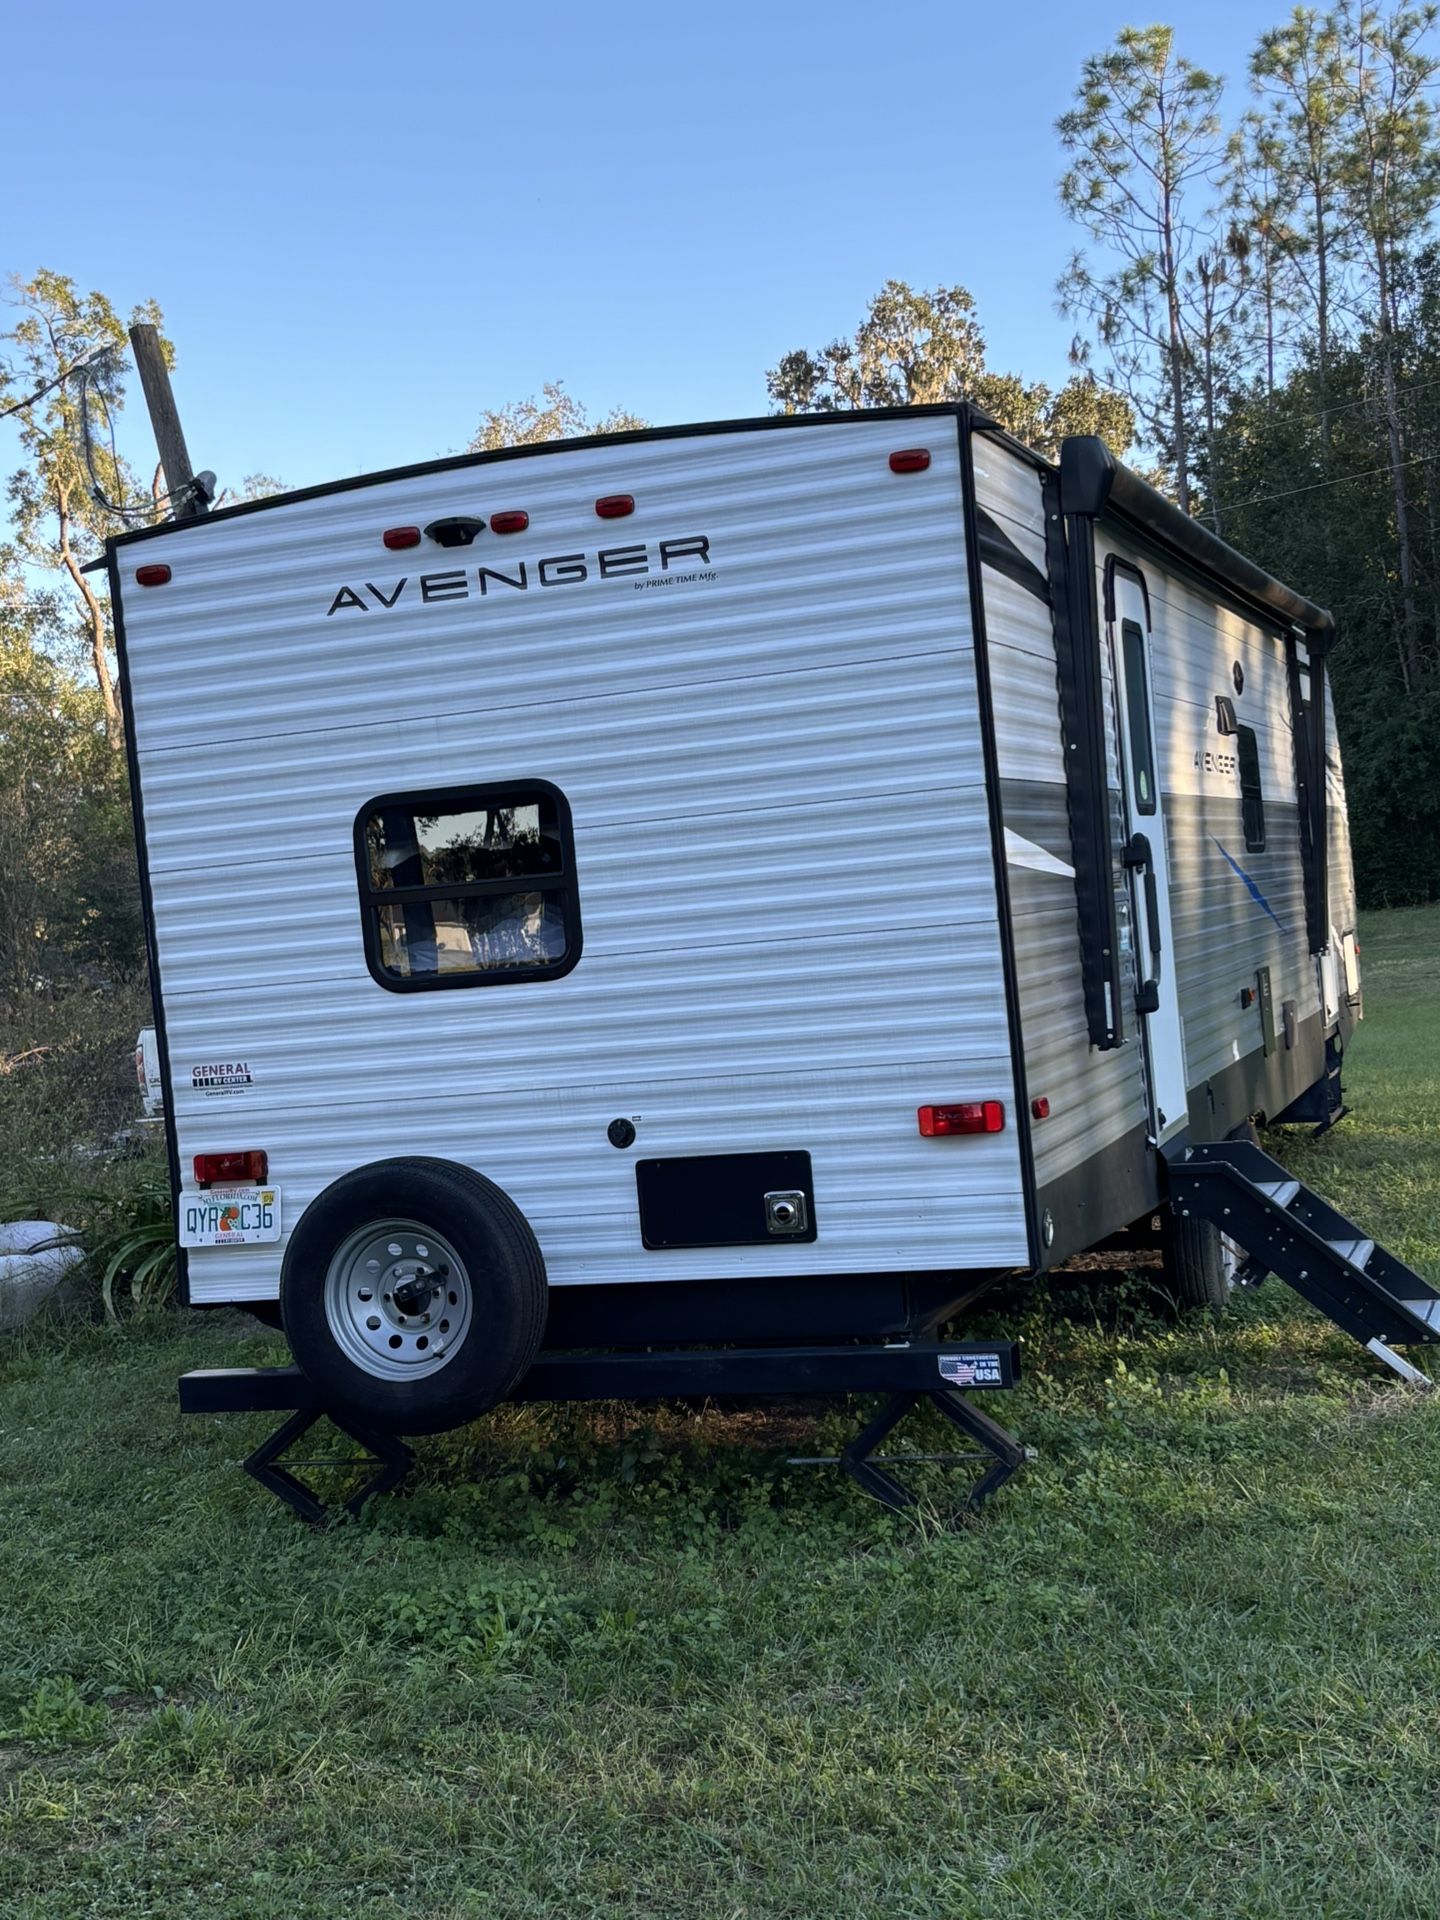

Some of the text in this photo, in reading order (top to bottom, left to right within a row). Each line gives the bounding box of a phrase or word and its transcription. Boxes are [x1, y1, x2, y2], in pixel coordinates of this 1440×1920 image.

[327, 535, 710, 616] AVENGER
[634, 571, 719, 591] by PRIME TIME Mfg.
[192, 1062, 251, 1077] GENERAL
[187, 1203, 273, 1234] QYR C36
[975, 1368, 1000, 1381] USA
